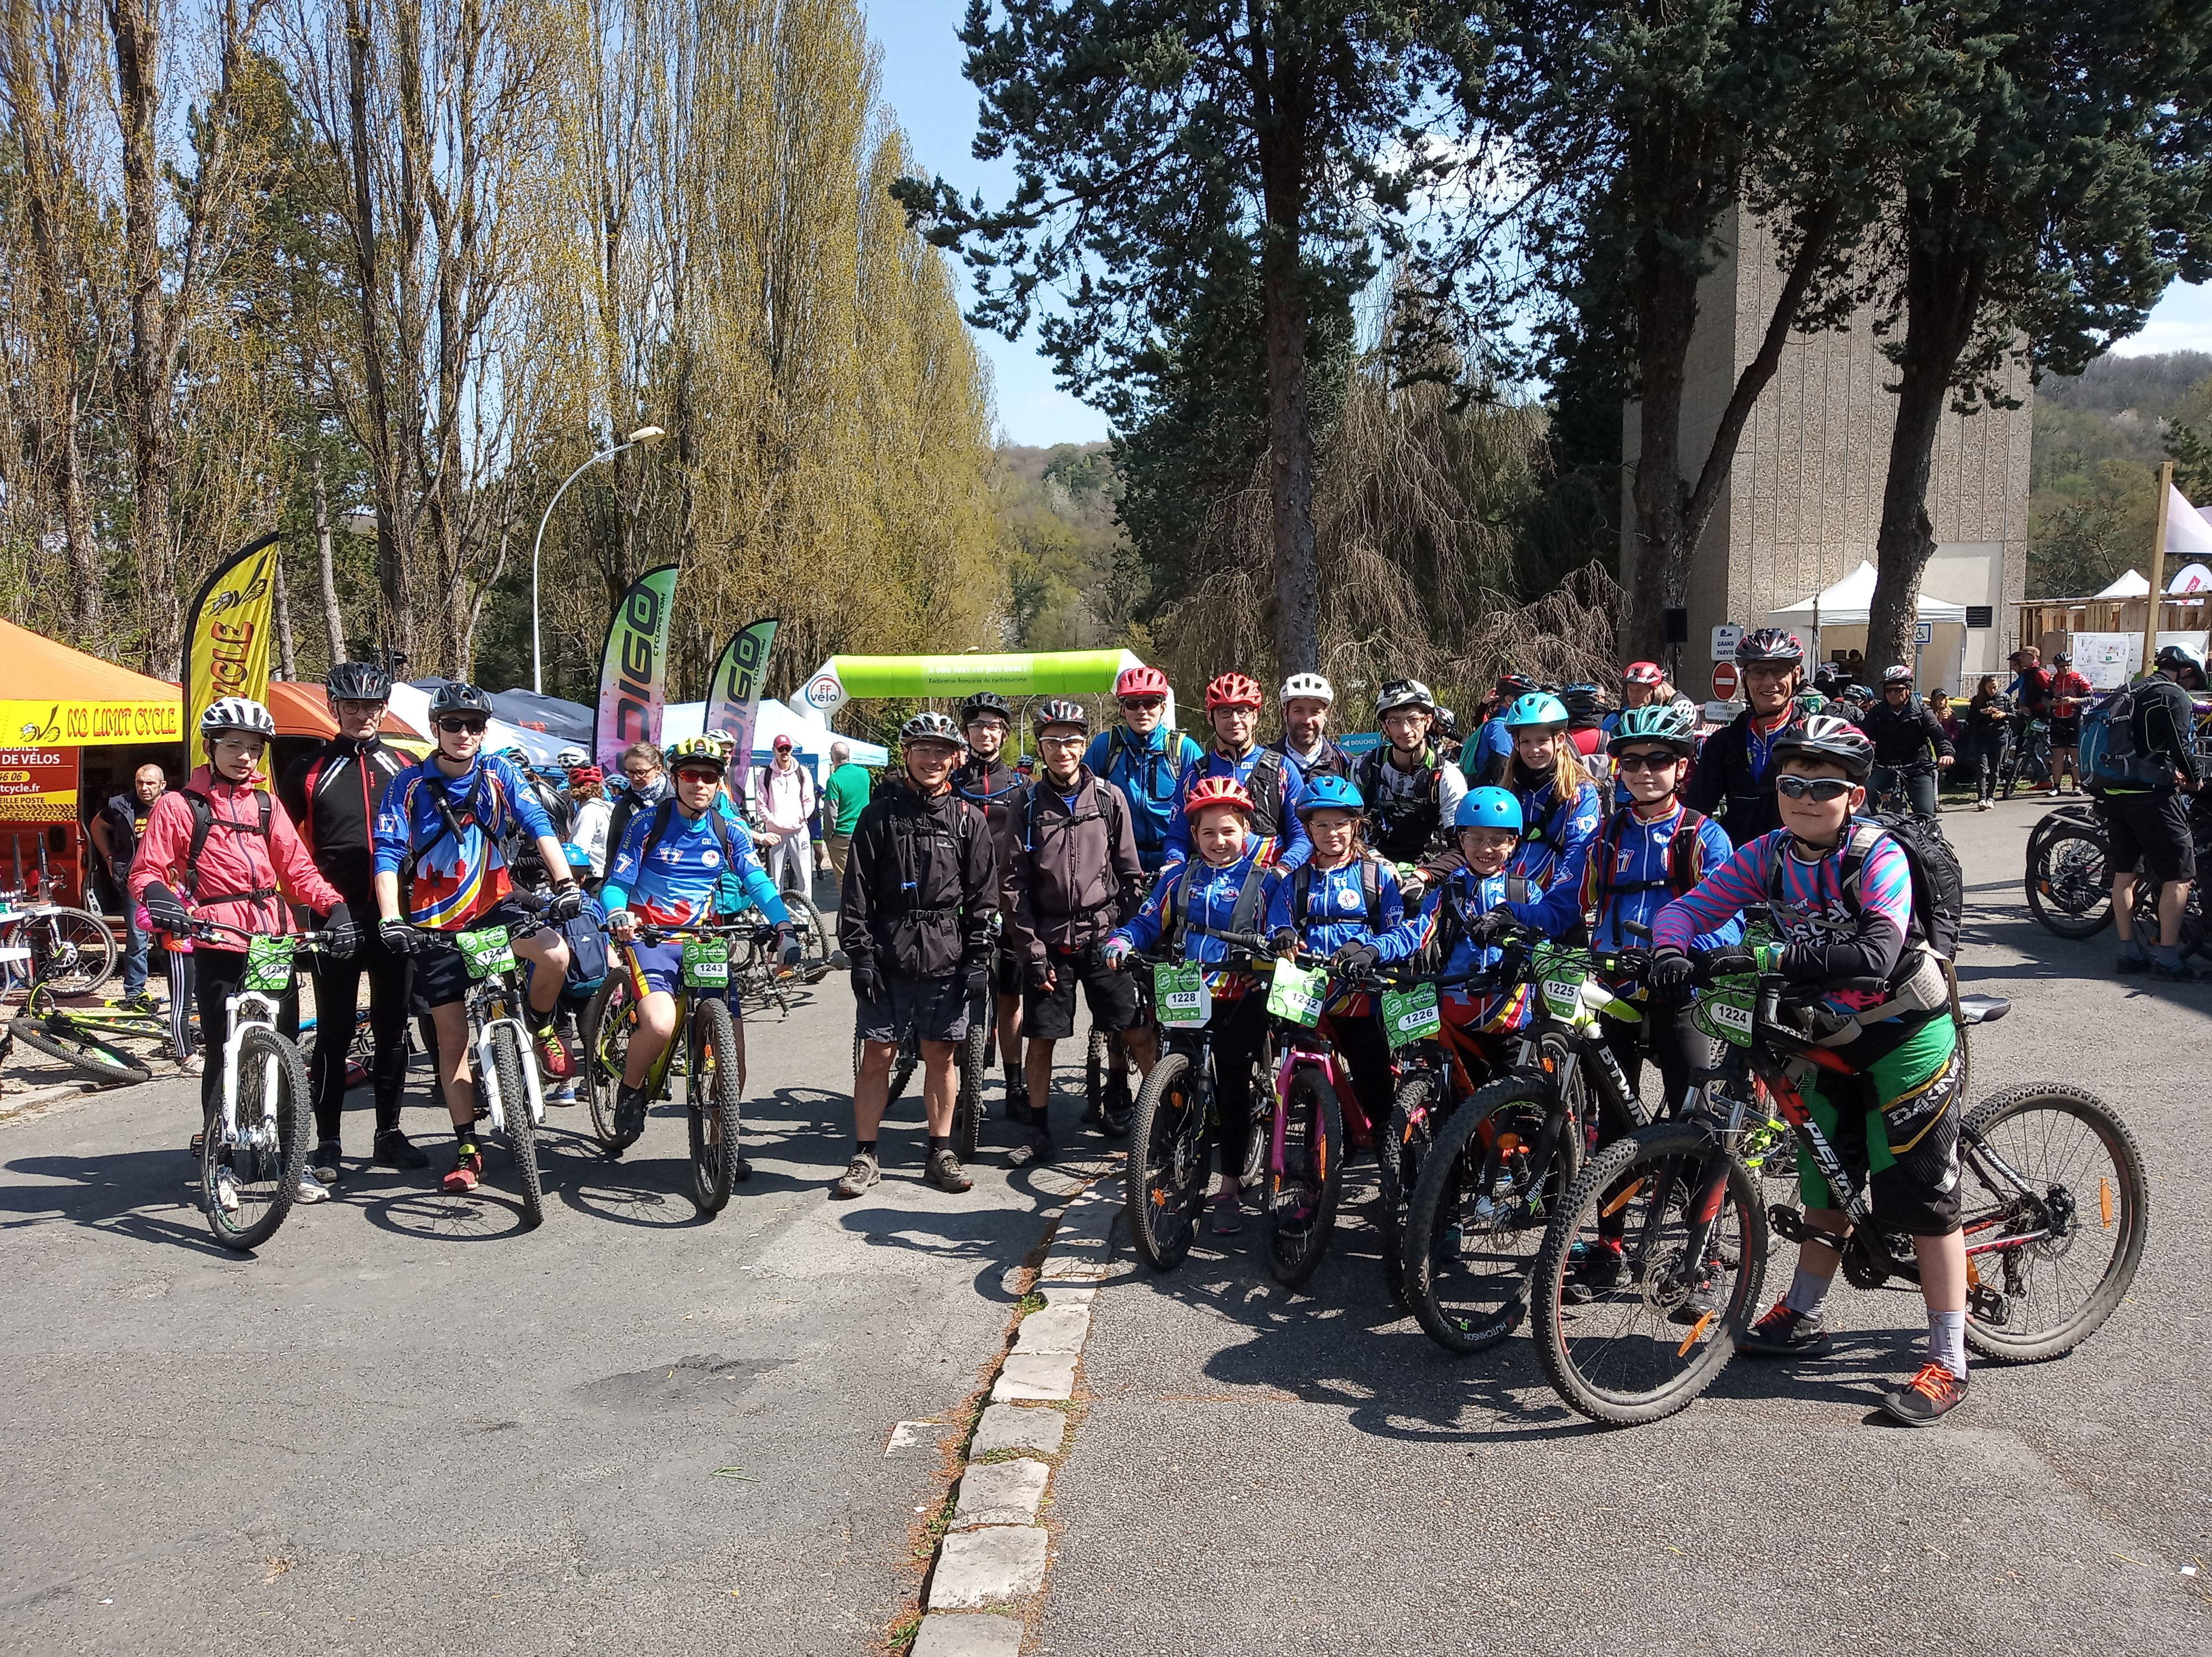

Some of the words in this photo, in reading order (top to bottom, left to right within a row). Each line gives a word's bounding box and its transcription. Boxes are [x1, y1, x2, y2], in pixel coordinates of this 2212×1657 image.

[653, 592, 666, 657] CYCLING.COM
[752, 638, 767, 686] CYCLING.COM
[820, 684, 832, 693] FF
[810, 691, 837, 702] vélo
[67, 707, 89, 738] NO
[93, 707, 132, 737] LIMIT
[134, 707, 177, 737] CYCLE
[2, 754, 19, 765] DE
[20, 752, 60, 765] VÉLOS
[10, 772, 23, 781] 06
[0, 783, 41, 794] tcycle.fr
[700, 964, 723, 972] 1243
[1548, 982, 1575, 997] 1225
[1172, 993, 1196, 1003] 1228
[1293, 992, 1319, 1009] 1242
[1405, 1009, 1434, 1024] 1226
[1718, 1005, 1747, 1025] 1224
[1977, 1141, 2033, 1193] LAPIERRE
[1739, 1259, 1759, 1321] KENDATIRE.COM
[1463, 1322, 1508, 1341] HUTCHINSON
